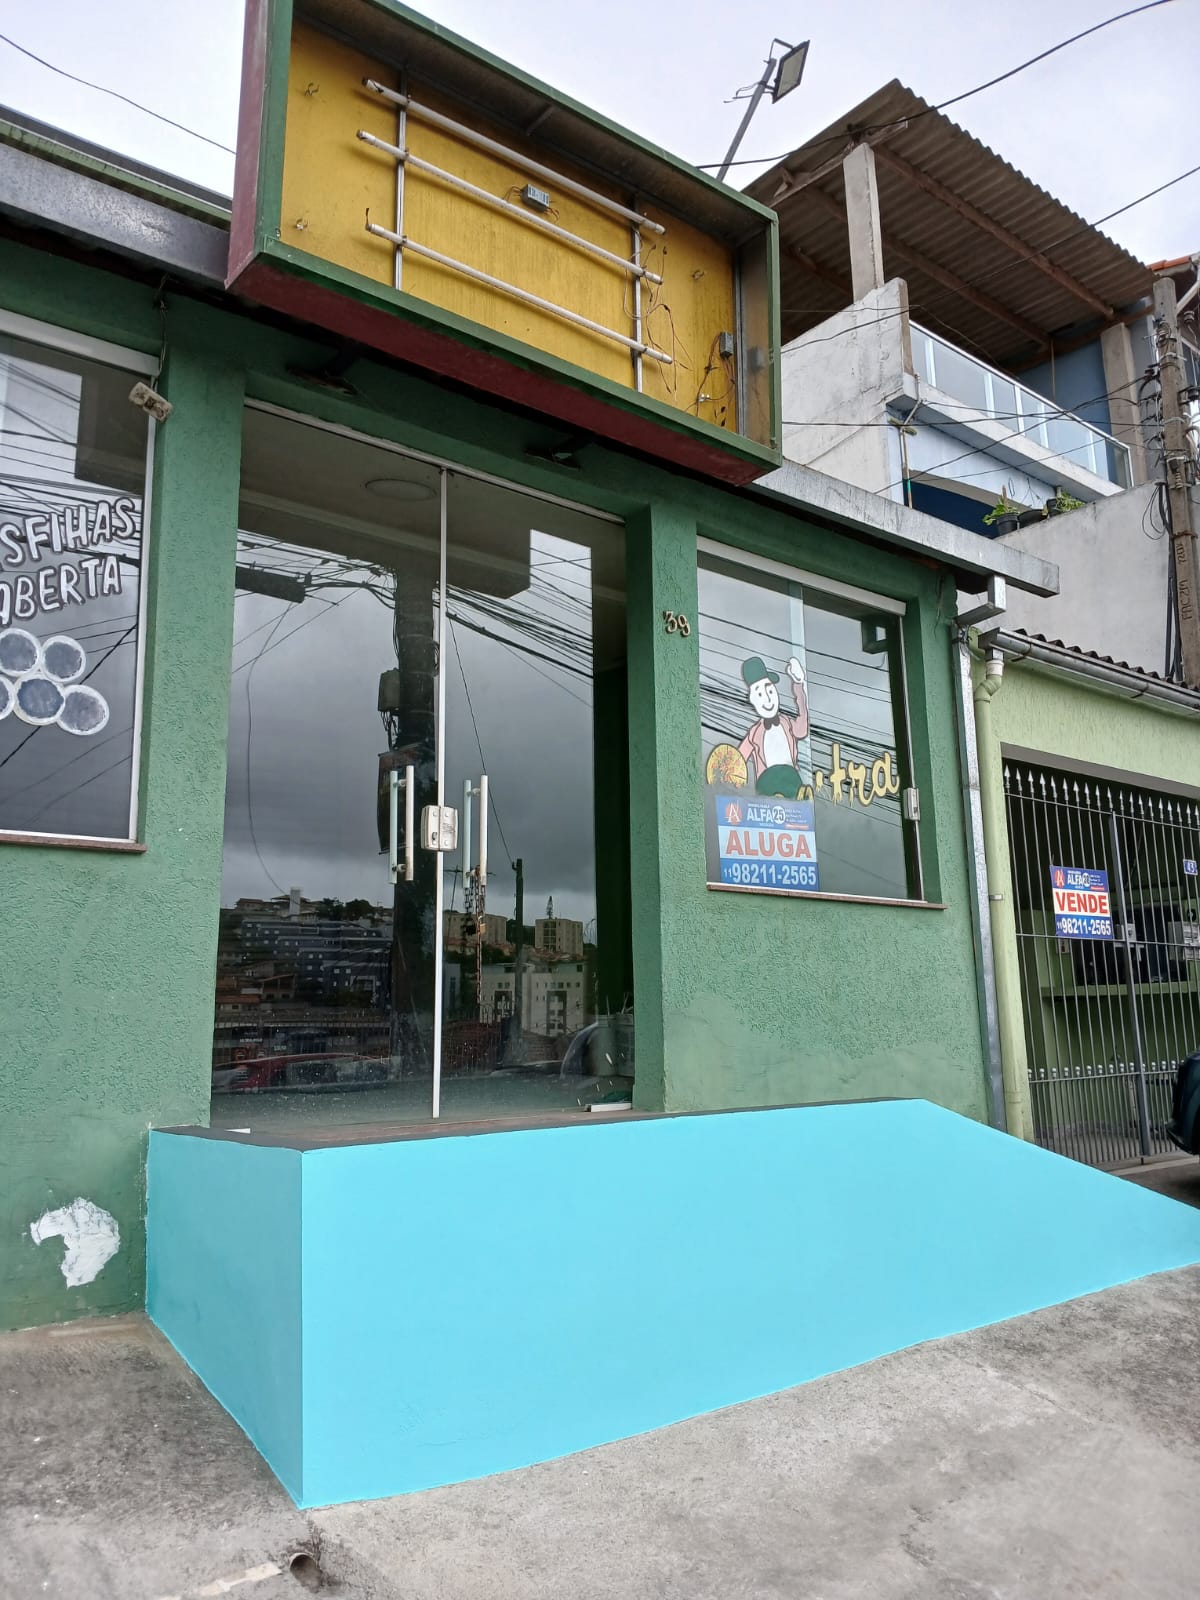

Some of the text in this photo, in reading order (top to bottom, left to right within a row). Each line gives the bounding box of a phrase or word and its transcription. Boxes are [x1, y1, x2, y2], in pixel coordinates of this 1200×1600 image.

[0, 497, 136, 565] SFIHAS
[662, 611, 691, 637] 39
[746, 807, 773, 823] ALFA
[725, 829, 812, 859] ALUGA
[732, 862, 817, 886] 98211-2565
[1055, 891, 1109, 914] VENDE
